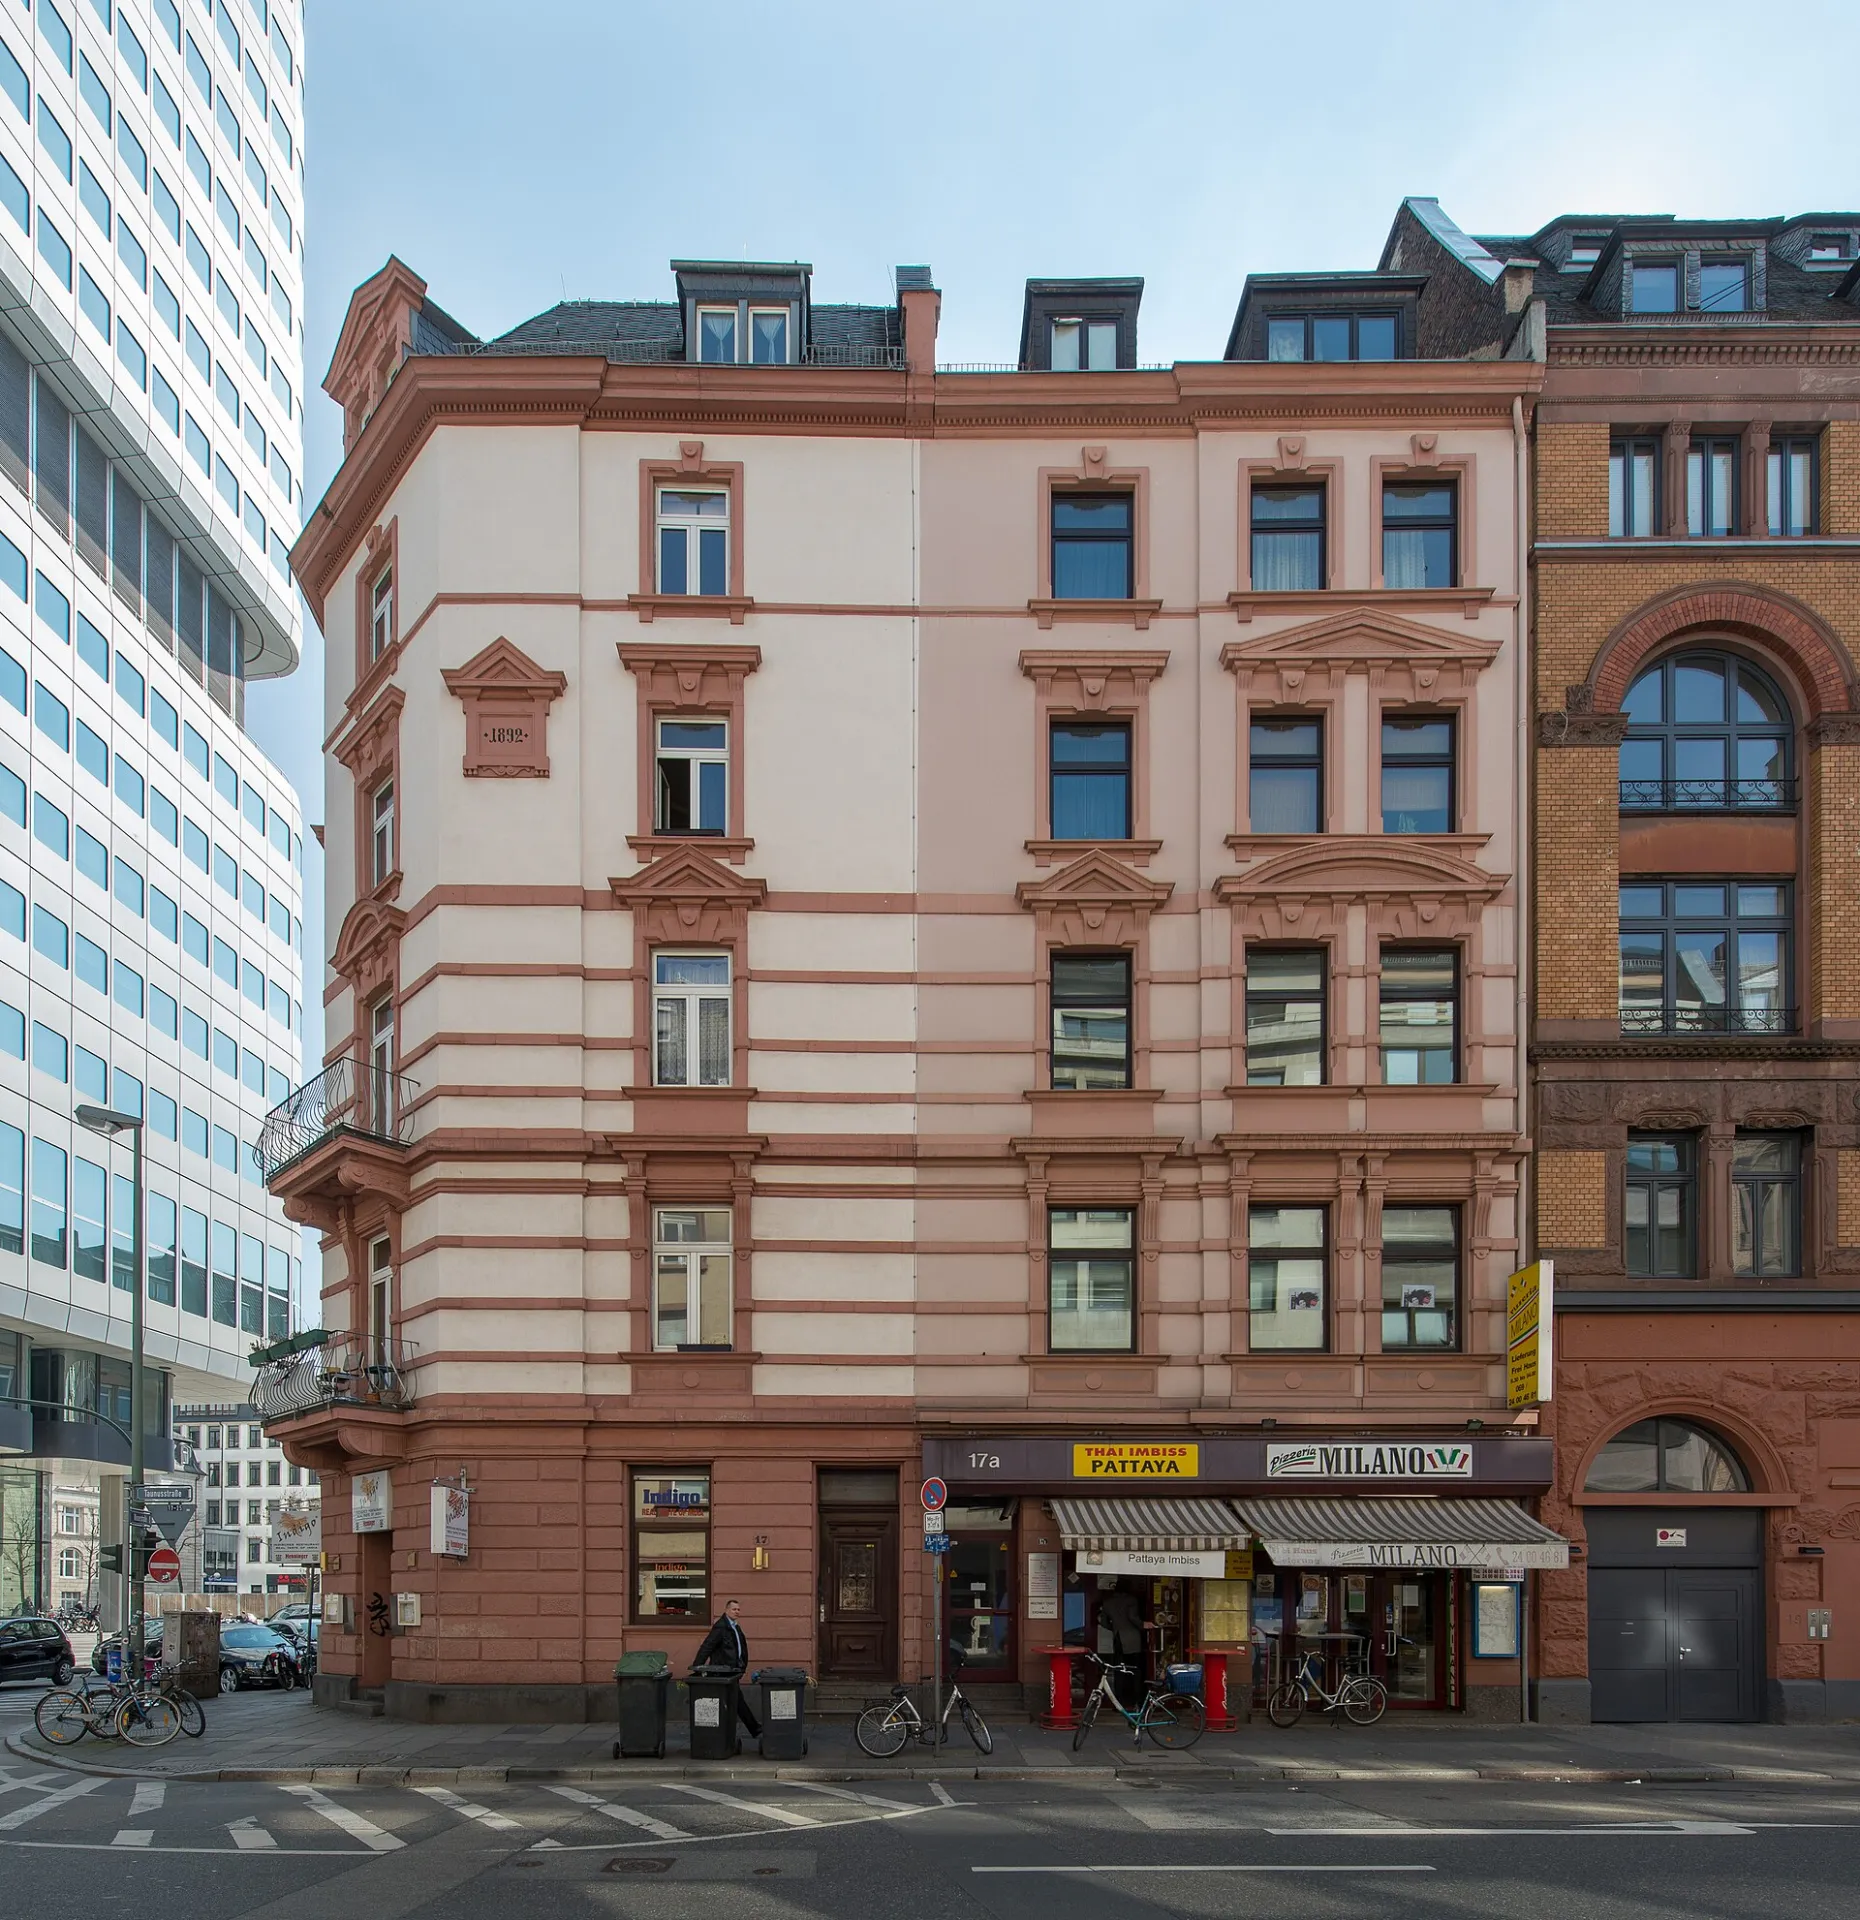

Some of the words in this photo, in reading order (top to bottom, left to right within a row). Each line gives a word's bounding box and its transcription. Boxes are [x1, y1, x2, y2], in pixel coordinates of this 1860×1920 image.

[1511, 1302, 1537, 1339] MILANO
[1511, 1349, 1536, 1362] Lieferung
[1511, 1365, 1522, 1374] Frei
[1524, 1361, 1536, 1370] Haus
[1516, 1383, 1525, 1392] 069
[1085, 1448, 1123, 1456] THAI
[1129, 1448, 1187, 1456] IMBISS
[968, 1453, 1000, 1468] 17a
[1270, 1445, 1317, 1472] Pizzeria
[1319, 1447, 1425, 1474] MILANO
[1092, 1460, 1180, 1473] PATTAYA
[144, 1490, 182, 1498] Taunusstraße
[643, 1489, 700, 1509] Indigo
[642, 1508, 657, 1516] REAL
[277, 1519, 316, 1542] Indigo
[755, 1535, 768, 1544] 17
[1293, 1547, 1318, 1555] Haus
[1331, 1546, 1364, 1560] Pizzeria
[1368, 1545, 1457, 1566] MILANO
[1512, 1551, 1523, 1563] 24
[1526, 1551, 1537, 1563] 00
[1540, 1551, 1551, 1563] 46
[1554, 1552, 1563, 1563] 81
[1128, 1554, 1165, 1565] Pattaya
[1168, 1555, 1200, 1565] Imbiss
[655, 1563, 687, 1573] Indigo
